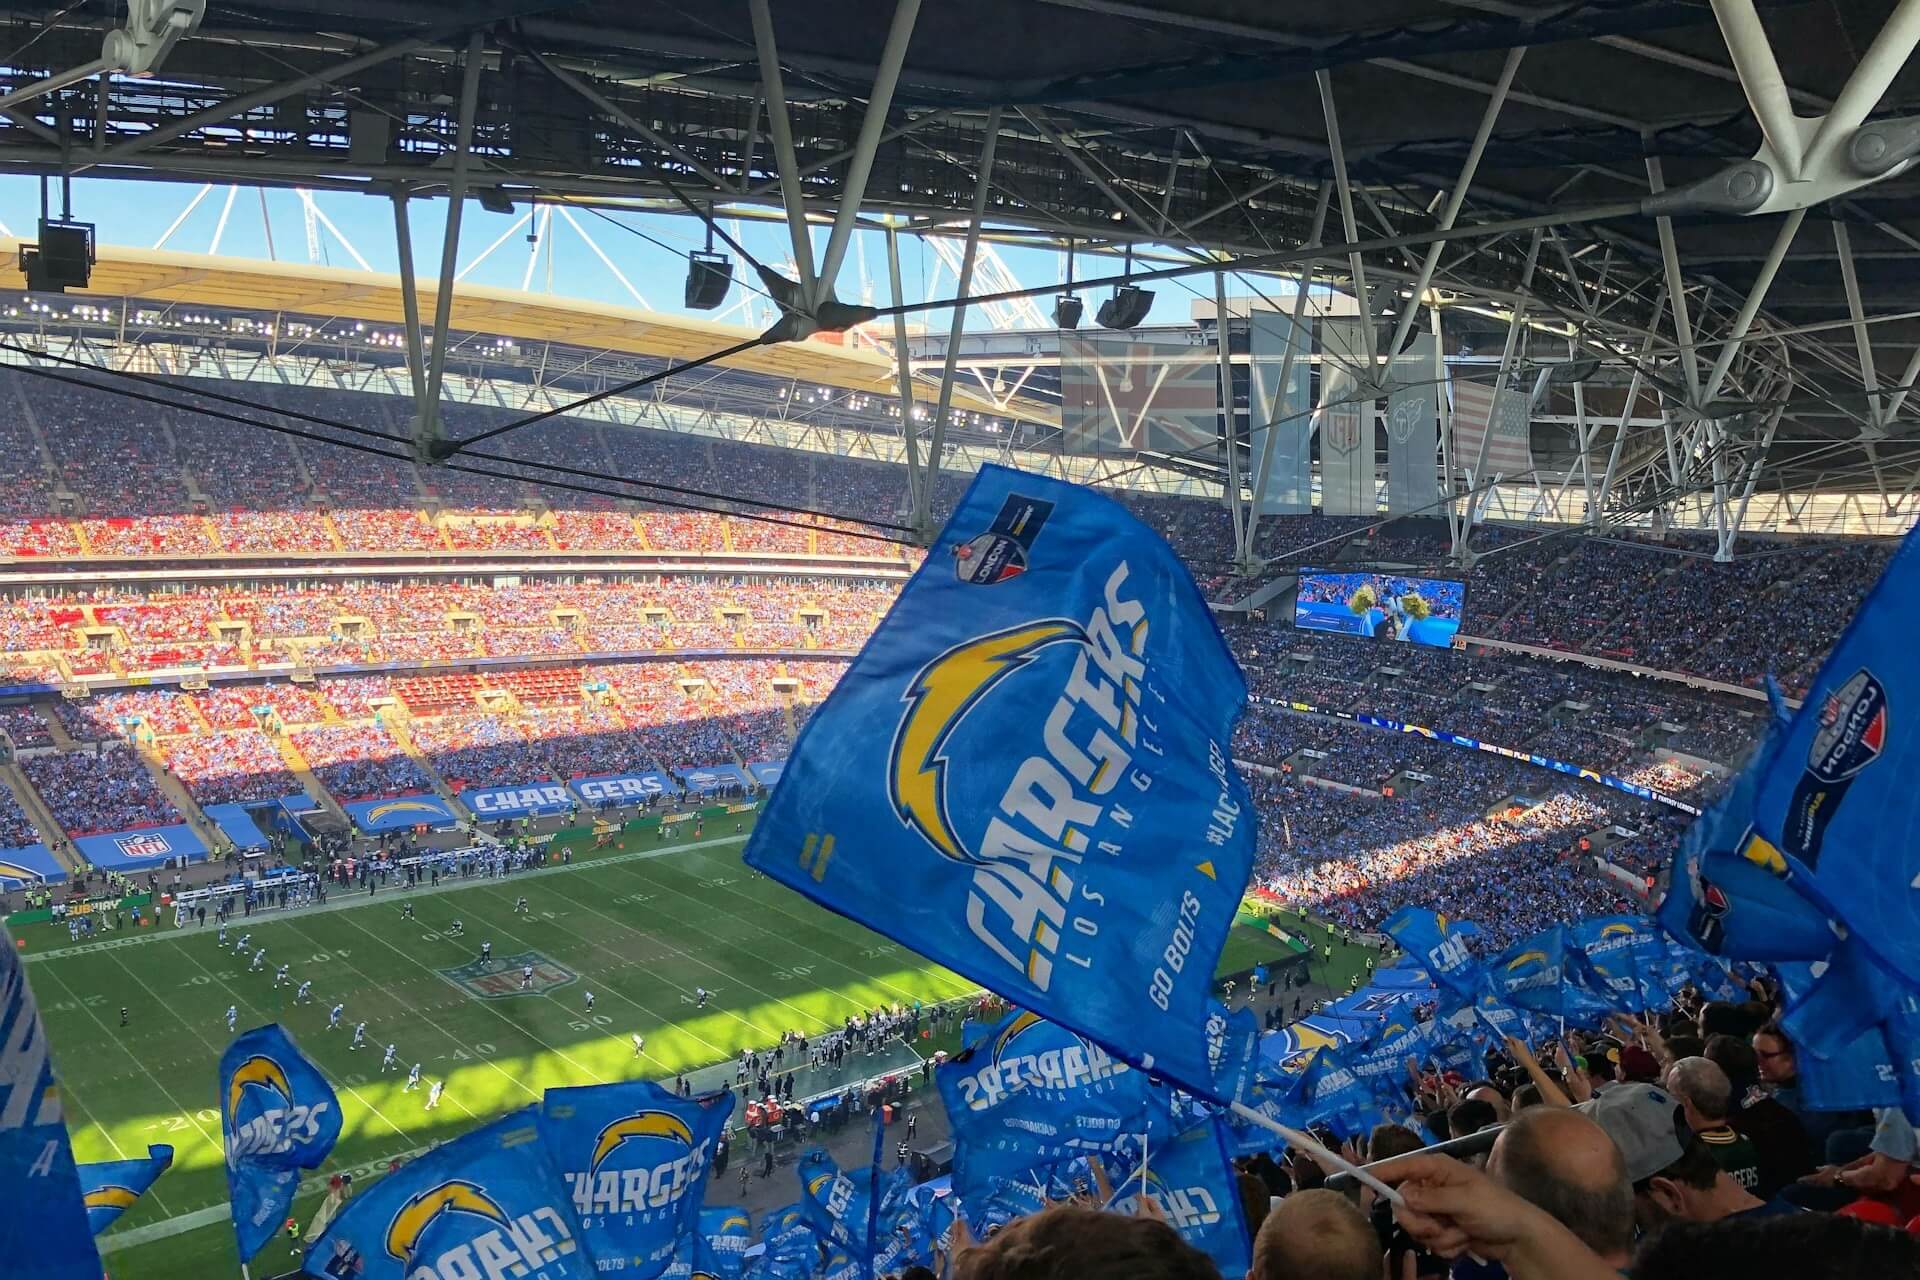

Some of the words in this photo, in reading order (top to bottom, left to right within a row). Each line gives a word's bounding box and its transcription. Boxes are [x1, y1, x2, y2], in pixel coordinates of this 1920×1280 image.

[474, 785, 570, 813] CHAR
[579, 775, 663, 801] GERS
[662, 811, 697, 824] SUBWAY
[727, 801, 759, 815] SUBWAY
[126, 841, 167, 856] NFL
[65, 898, 122, 917] SUBWAY
[1066, 883, 1105, 969] LOS
[1149, 967, 1173, 1012] GO
[1163, 889, 1201, 974] BOLTS
[567, 1015, 613, 1032] 50
[452, 1043, 497, 1062] 40
[162, 1108, 222, 1134] 20
